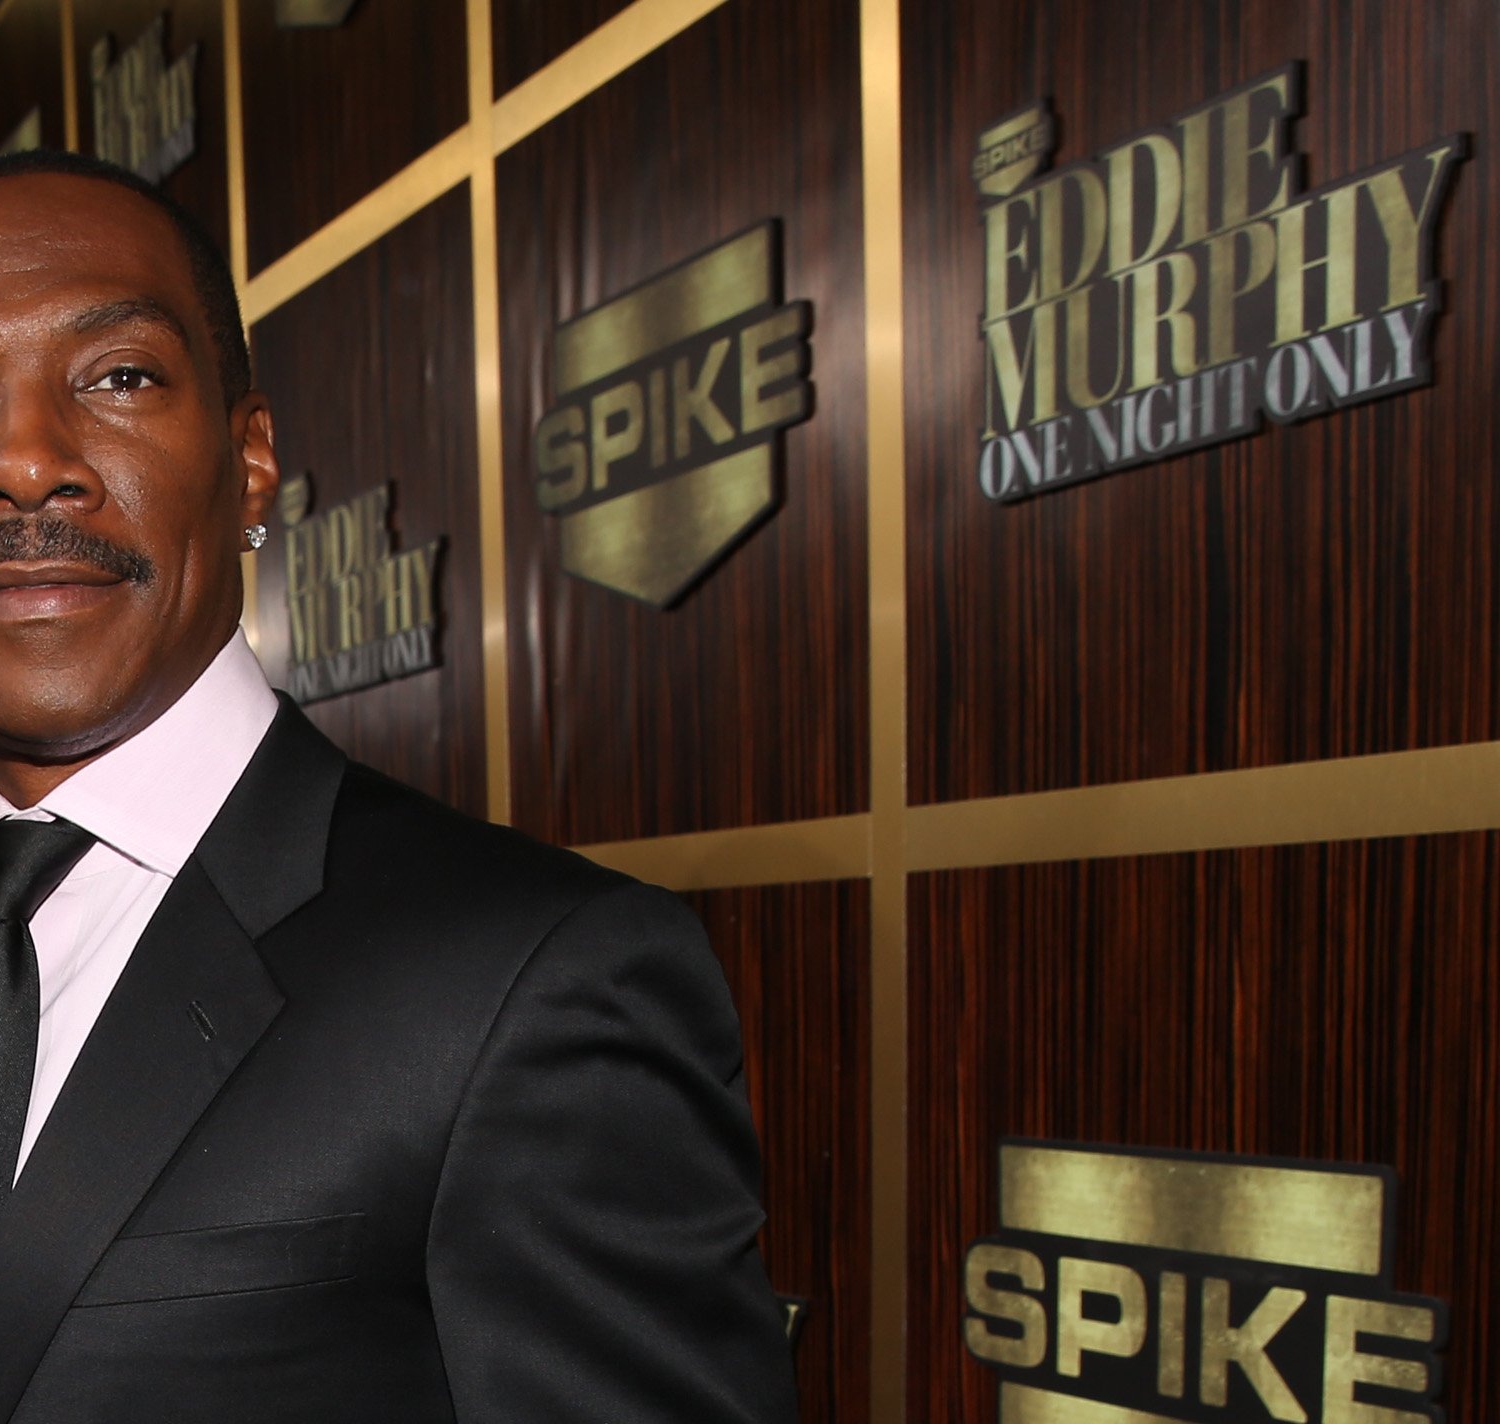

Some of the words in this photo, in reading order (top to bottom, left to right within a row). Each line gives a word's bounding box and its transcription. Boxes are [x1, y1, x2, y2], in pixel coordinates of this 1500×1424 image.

[973, 123, 1046, 179] SPIKE
[983, 73, 1290, 331] EDDIE
[982, 146, 1452, 442] MURPHY
[536, 306, 802, 505] SPIKE
[979, 415, 1073, 499] ONE
[1084, 356, 1258, 471] NIGHT
[1265, 300, 1427, 417] ONLY
[288, 540, 438, 664] MURPHY
